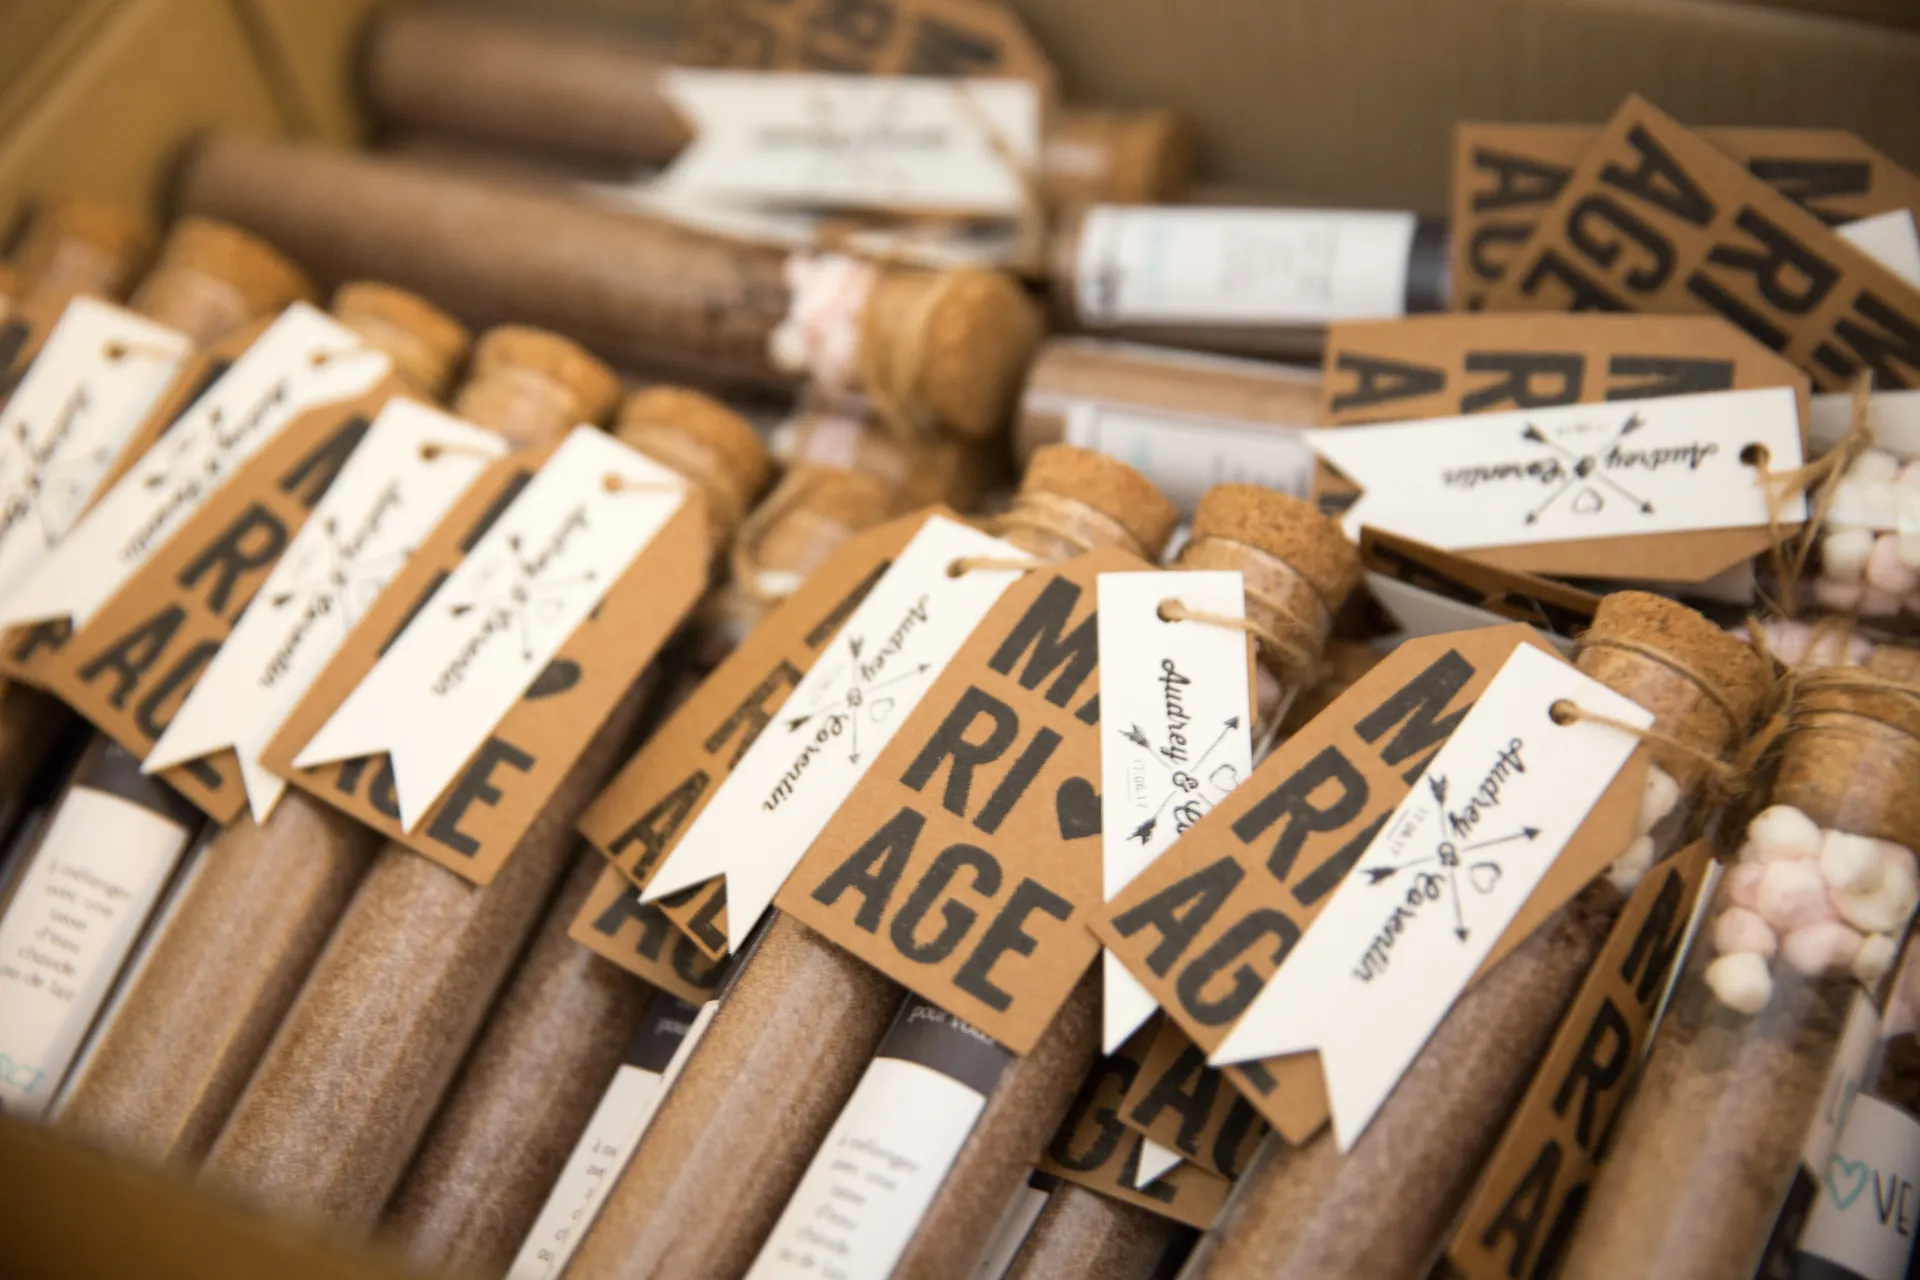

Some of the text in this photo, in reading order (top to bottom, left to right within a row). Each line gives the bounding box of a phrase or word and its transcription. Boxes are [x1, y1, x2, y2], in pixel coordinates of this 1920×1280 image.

[899, 685, 1064, 836] RI
[1158, 658, 1191, 766] Audrey
[1448, 737, 1527, 839] Audrey
[811, 806, 1076, 1013] AGE
[1352, 872, 1446, 982] Corentin
